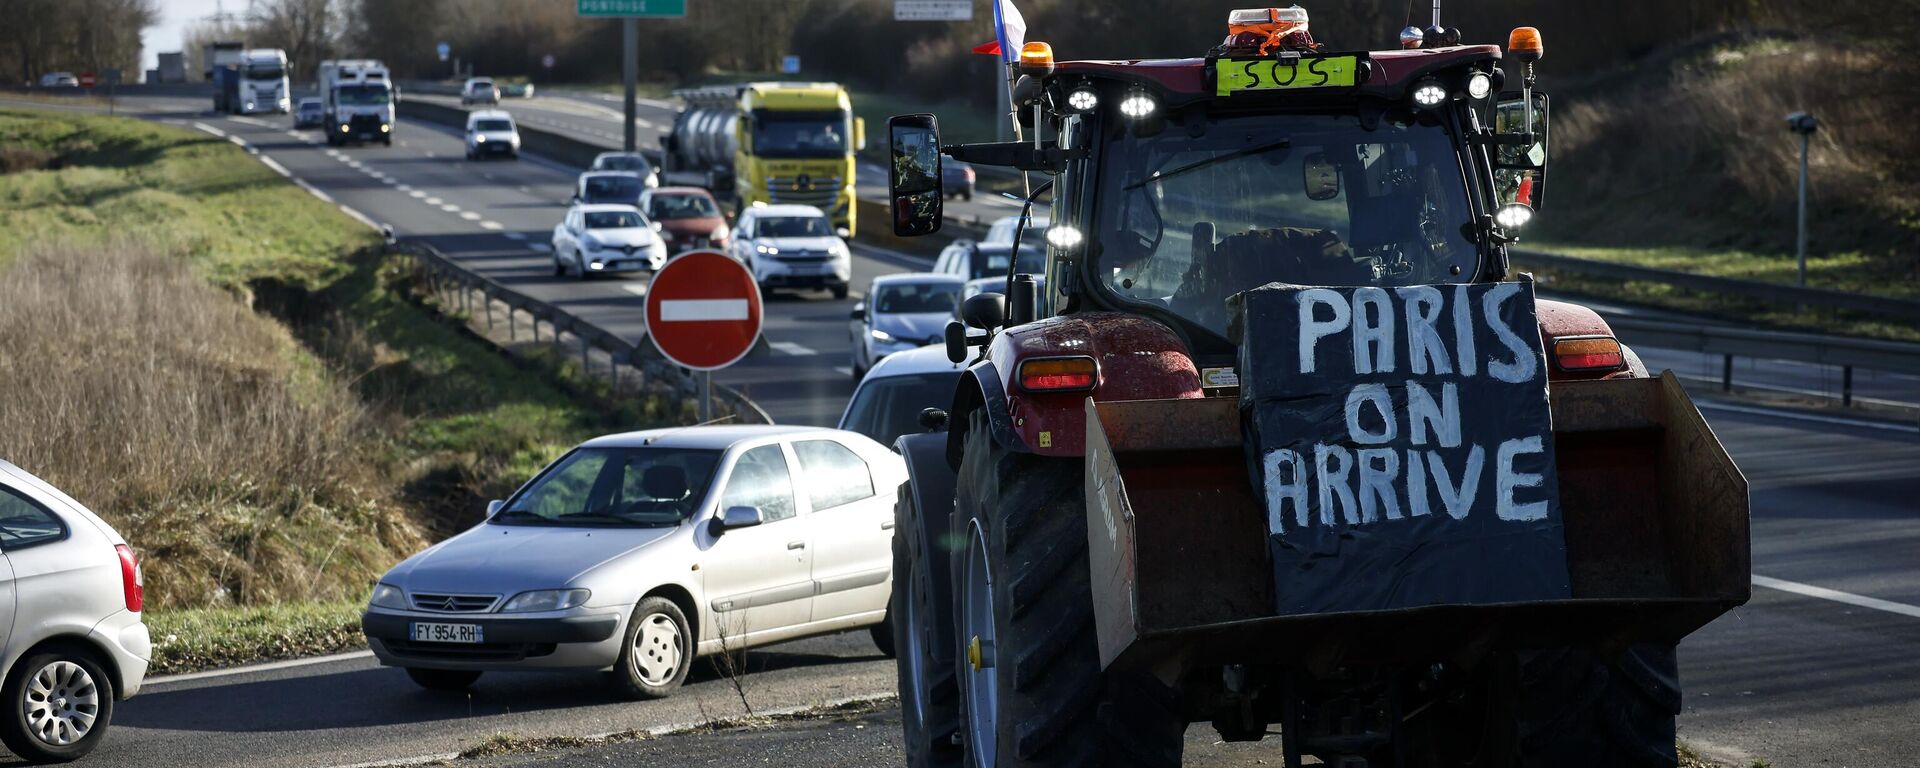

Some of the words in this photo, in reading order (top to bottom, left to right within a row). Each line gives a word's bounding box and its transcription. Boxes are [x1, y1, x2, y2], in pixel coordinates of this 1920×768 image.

[581, 0, 647, 12] PONTOISE
[1243, 58, 1329, 88] SOS
[1297, 284, 1538, 385] PARIS
[1345, 380, 1463, 449] ON
[1263, 435, 1550, 536] ARRIVE
